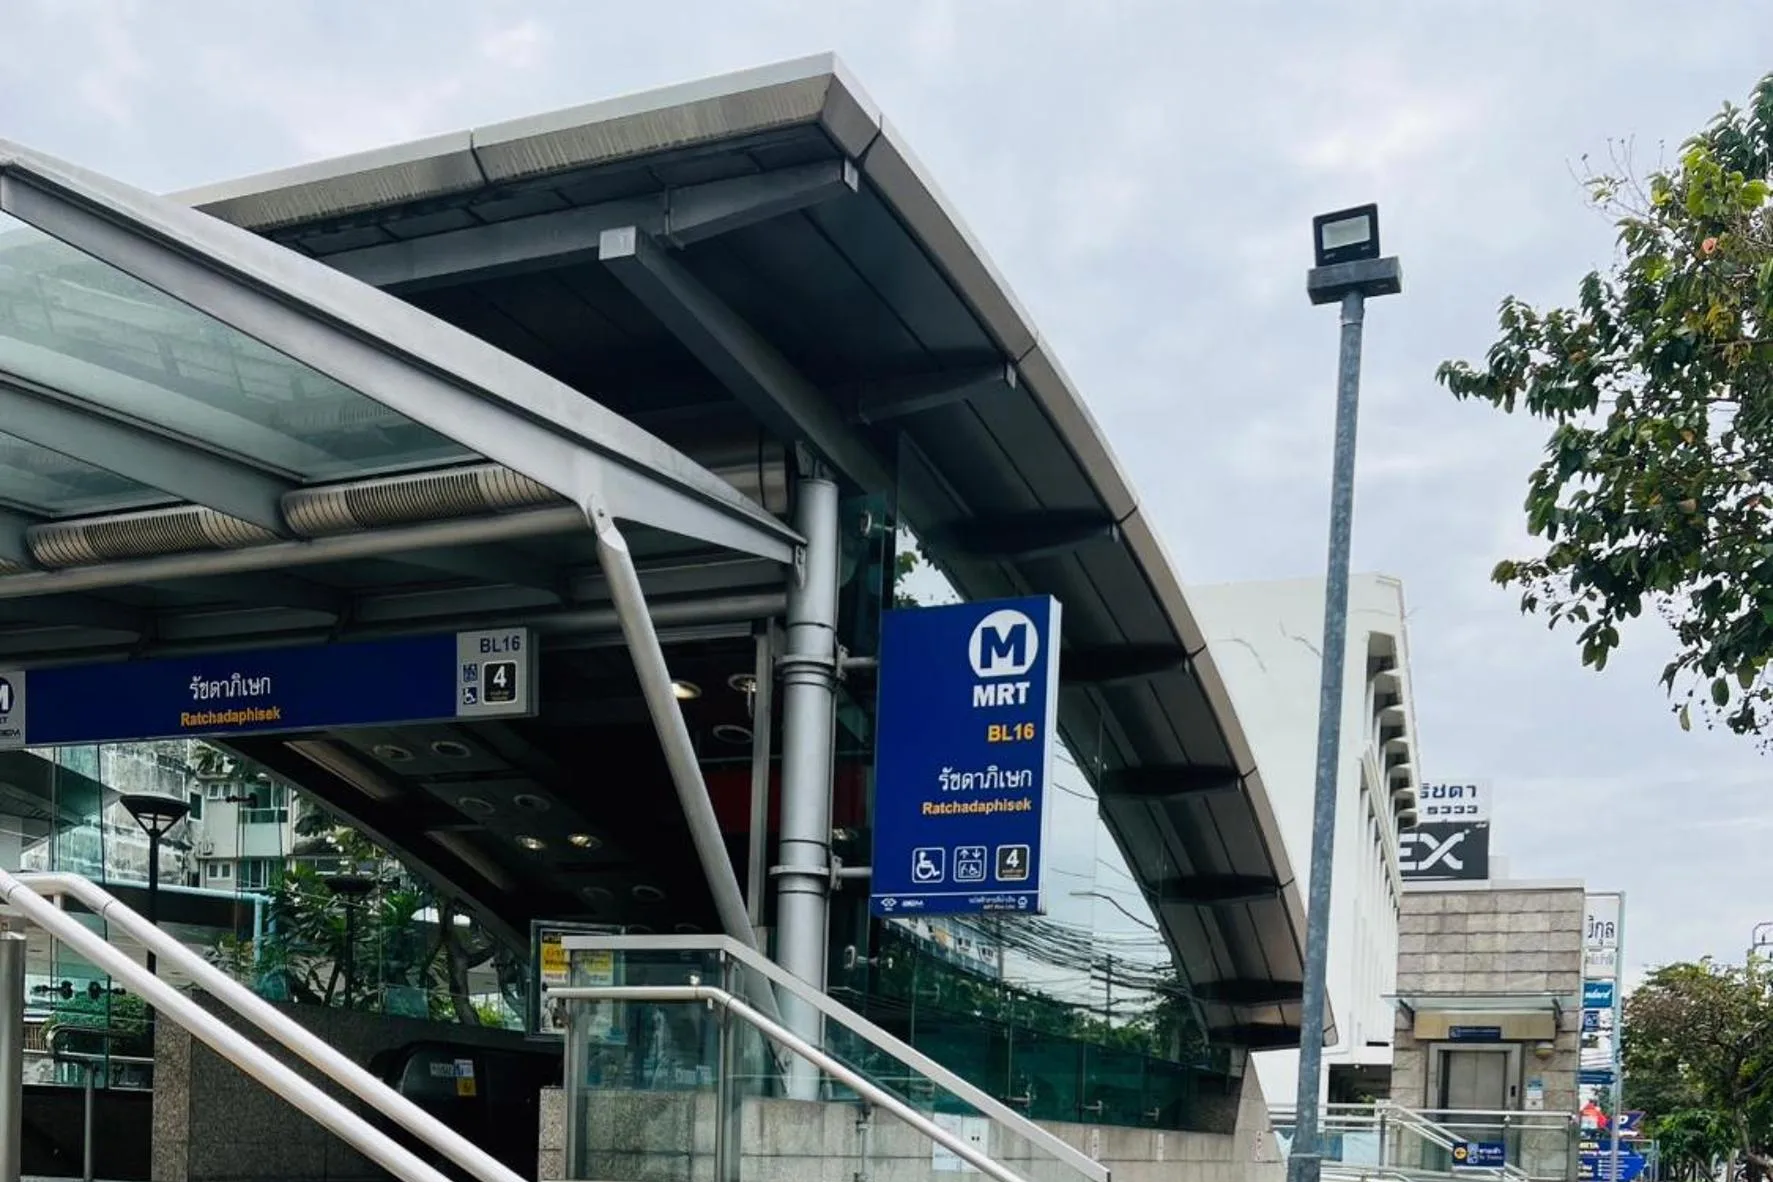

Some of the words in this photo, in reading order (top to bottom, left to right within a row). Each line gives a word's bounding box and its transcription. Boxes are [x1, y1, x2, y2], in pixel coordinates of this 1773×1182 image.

[480, 635, 521, 654] BL16
[189, 672, 272, 700] รัชดาภิเษก
[493, 665, 508, 688] 4
[972, 681, 1031, 709] MRT
[180, 705, 282, 728] Ratchadaphisek
[987, 722, 1035, 743] BL16
[937, 764, 1033, 792] รัชดาภิเษก
[922, 797, 1032, 816] Ratchadaphisek
[1006, 848, 1020, 868] 4
